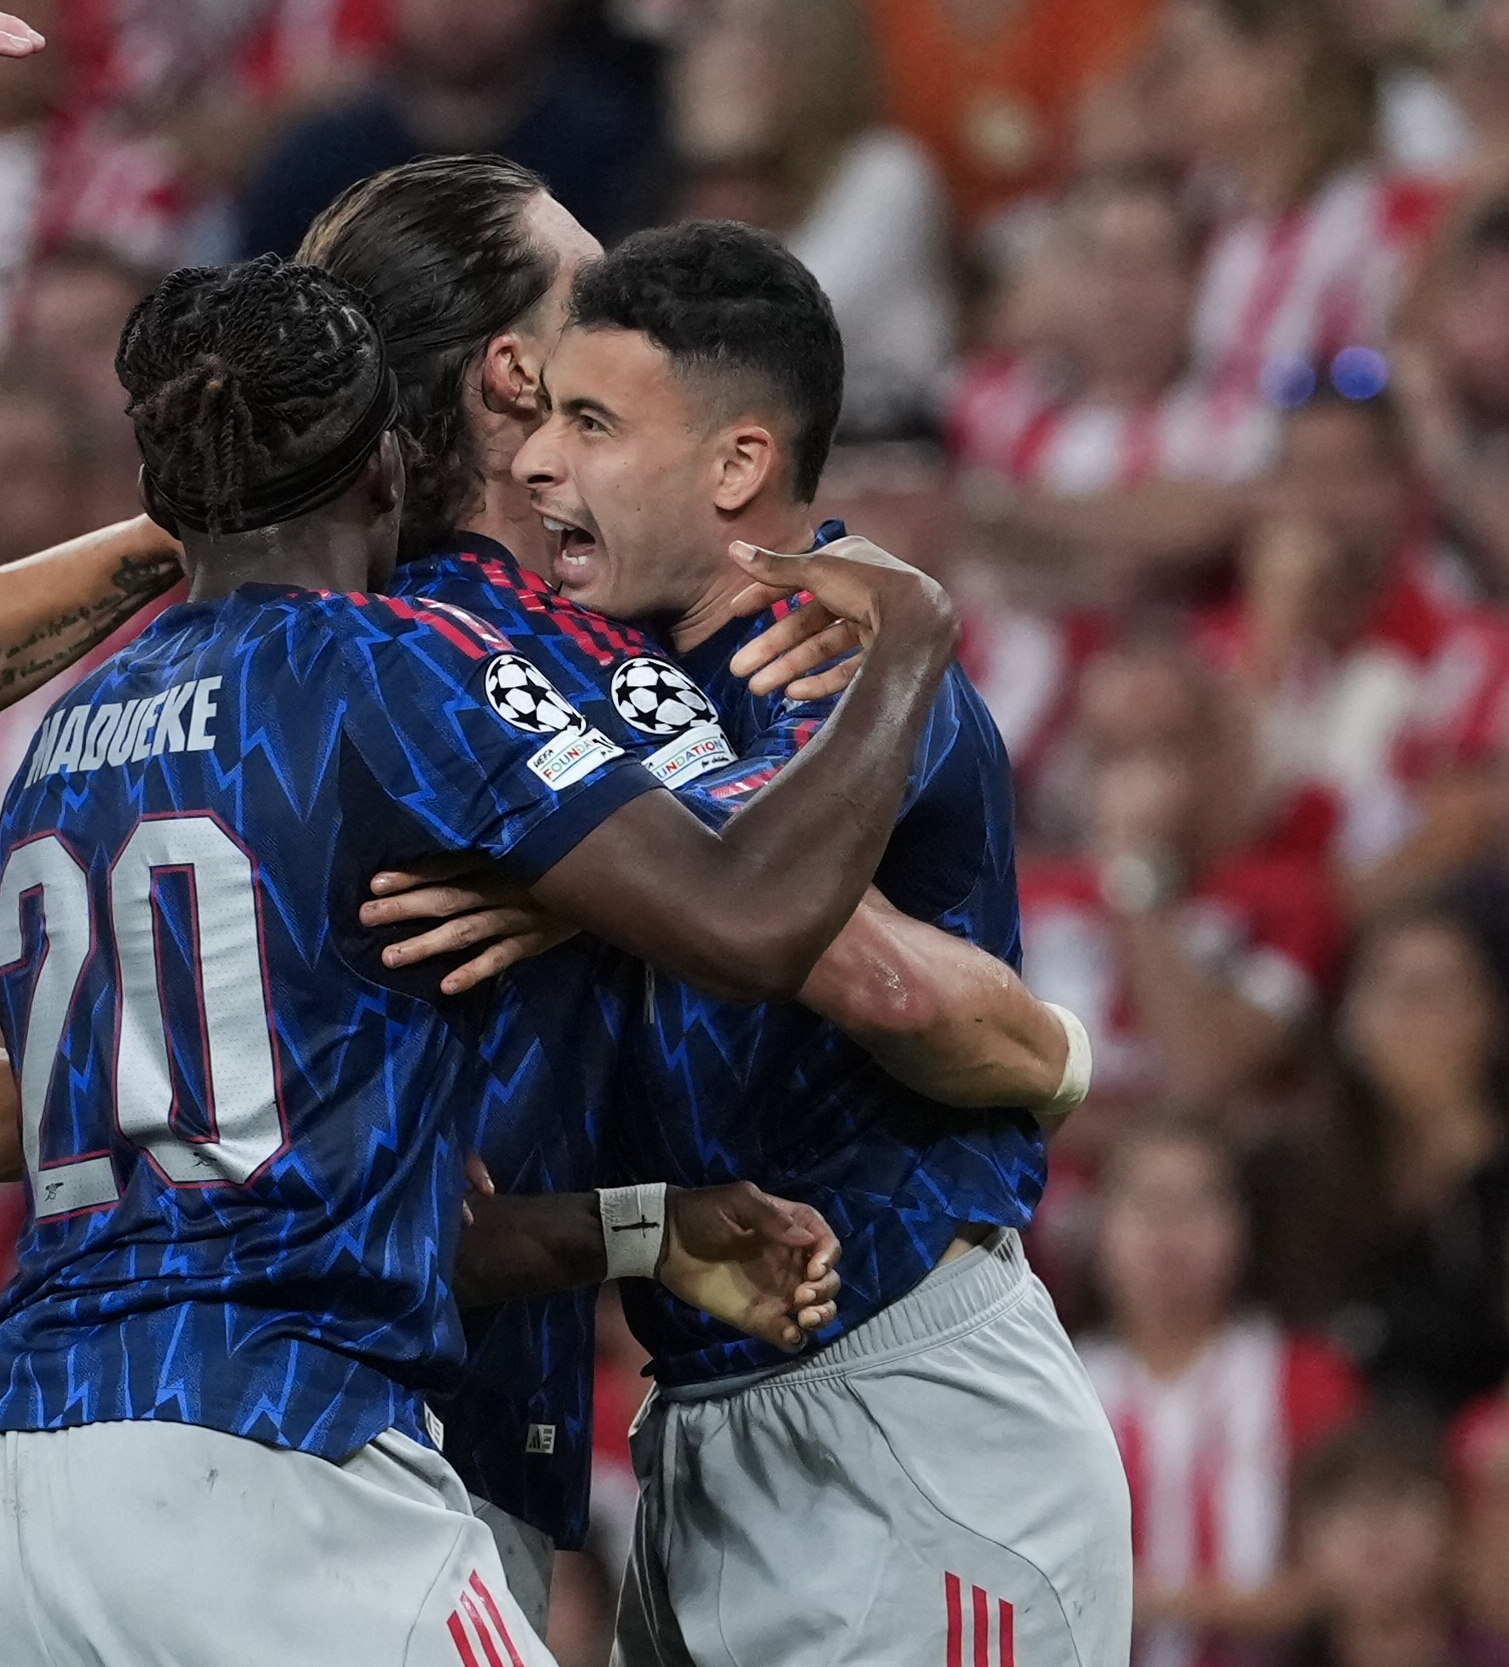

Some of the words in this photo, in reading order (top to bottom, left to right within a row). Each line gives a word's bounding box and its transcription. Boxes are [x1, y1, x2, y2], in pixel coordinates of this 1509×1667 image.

[24, 675, 223, 789] MADUEKE
[533, 749, 554, 769] UEFA
[655, 740, 724, 779] UNDATION
